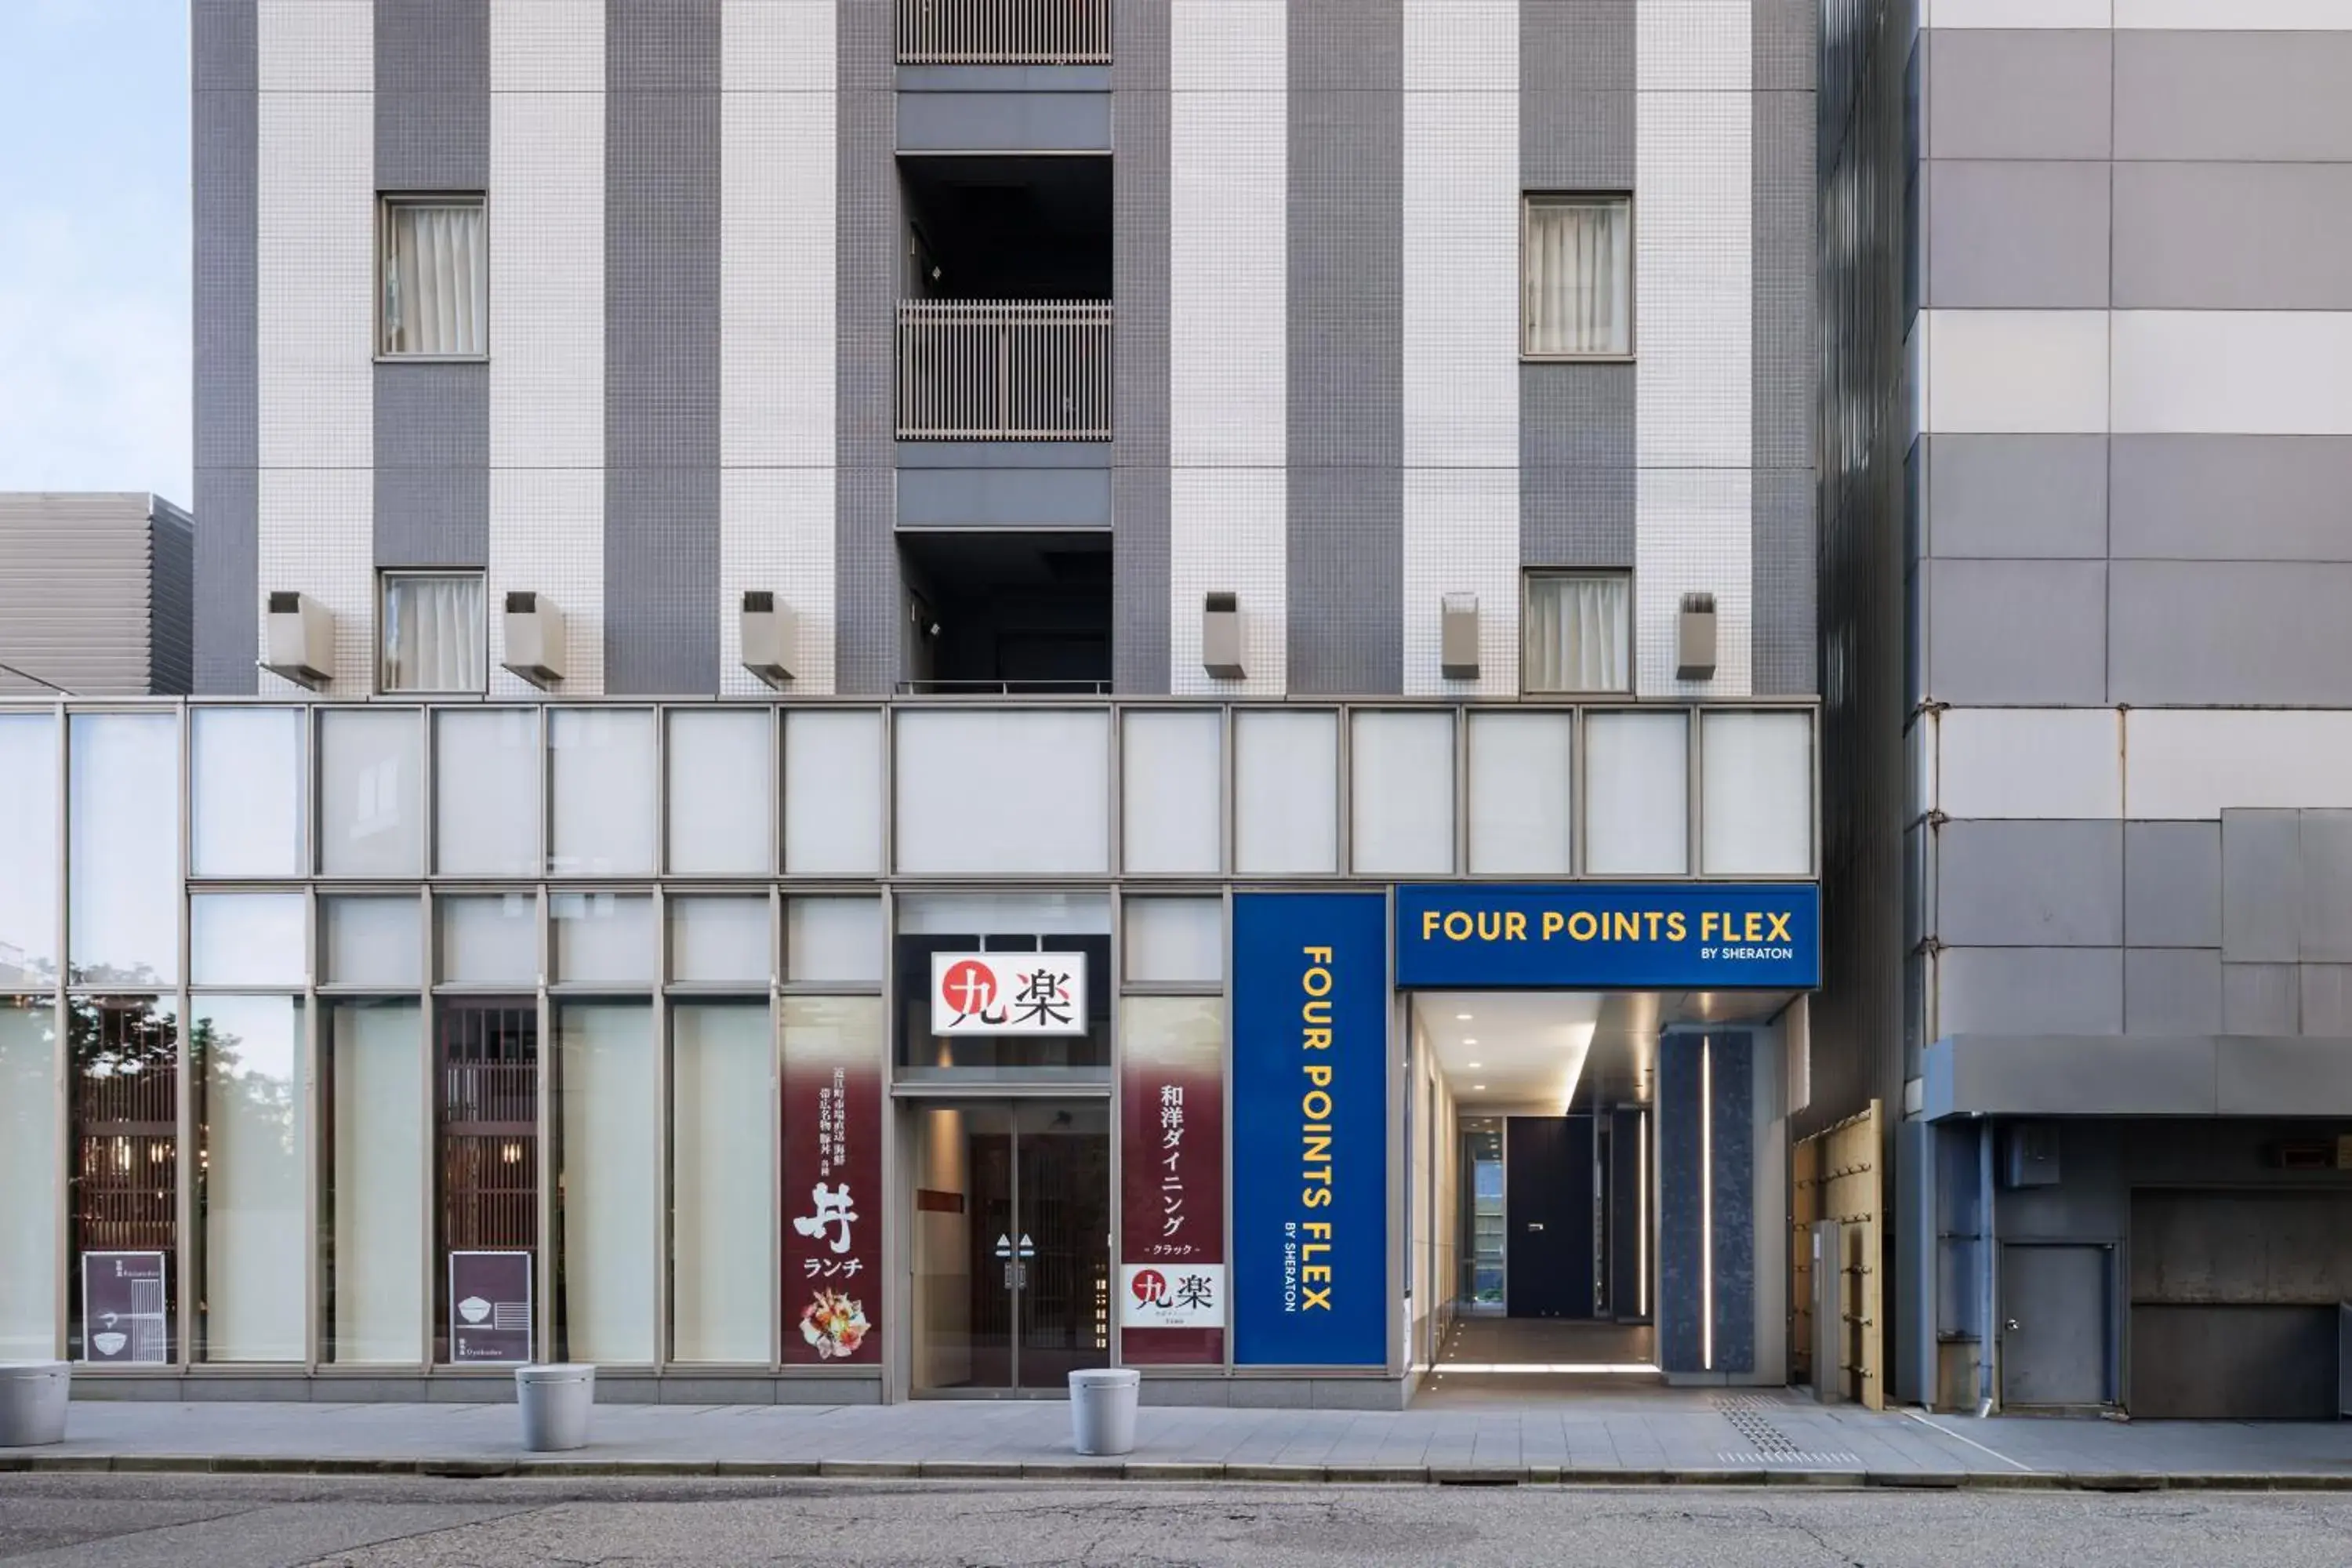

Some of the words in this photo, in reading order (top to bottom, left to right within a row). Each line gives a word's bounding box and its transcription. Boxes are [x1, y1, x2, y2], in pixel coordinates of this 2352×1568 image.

[1423, 911, 1527, 941] FOUR
[1542, 911, 1686, 942] POINTS
[1701, 912, 1791, 942] FLEX
[1701, 948, 1719, 959] BY
[1722, 948, 1792, 959] SHERATON
[948, 968, 1074, 1027] 九楽
[1302, 946, 1332, 1050] FOUR
[1160, 1085, 1185, 1236] 和洋ダイニング
[1302, 1065, 1332, 1208] POINTS
[1285, 1222, 1296, 1239] BY
[804, 1258, 863, 1279] ランチ
[1134, 1273, 1213, 1309] 九楽
[1285, 1243, 1296, 1312] SHERATON
[1302, 1222, 1331, 1311] FLEX
